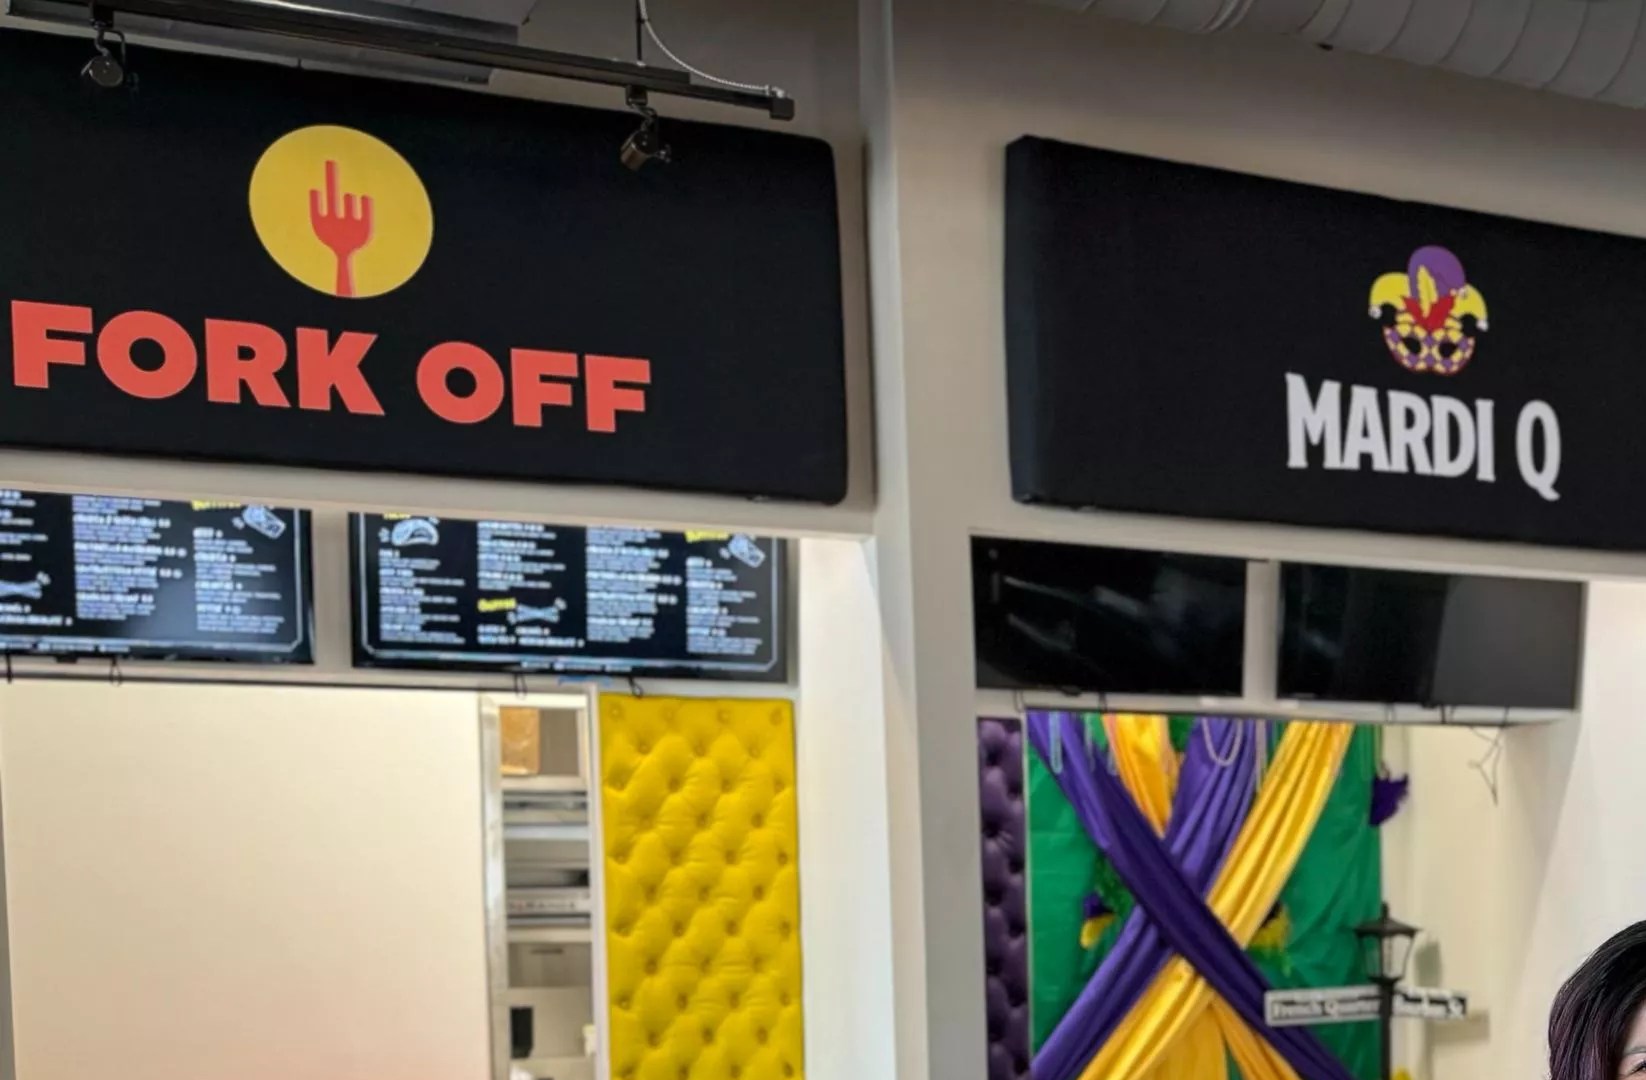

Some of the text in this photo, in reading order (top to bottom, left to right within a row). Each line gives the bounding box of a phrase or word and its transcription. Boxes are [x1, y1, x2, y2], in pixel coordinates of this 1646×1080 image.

[11, 300, 651, 433] FORK OFF
[1285, 372, 1561, 501] MARDI Q
